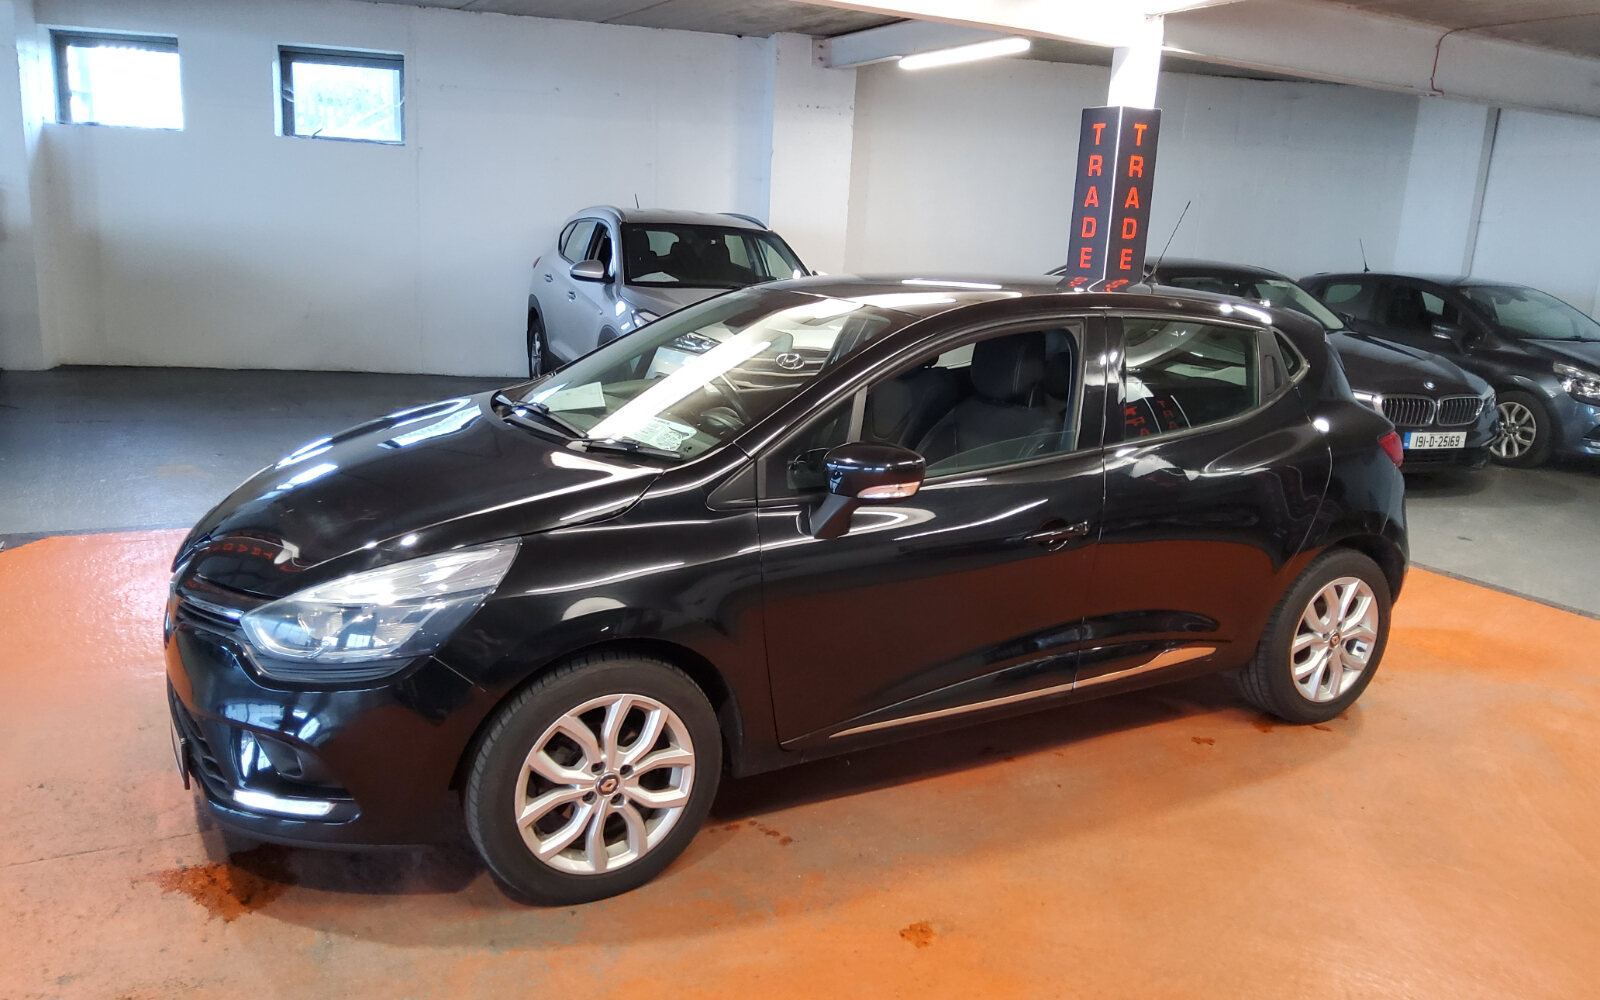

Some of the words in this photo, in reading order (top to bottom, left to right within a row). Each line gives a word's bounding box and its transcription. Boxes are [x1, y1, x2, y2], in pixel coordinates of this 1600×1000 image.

[1080, 123, 1106, 268] TRADE
[1120, 123, 1147, 270] TRADE
[1415, 435, 1460, 447] 191-D-25169
